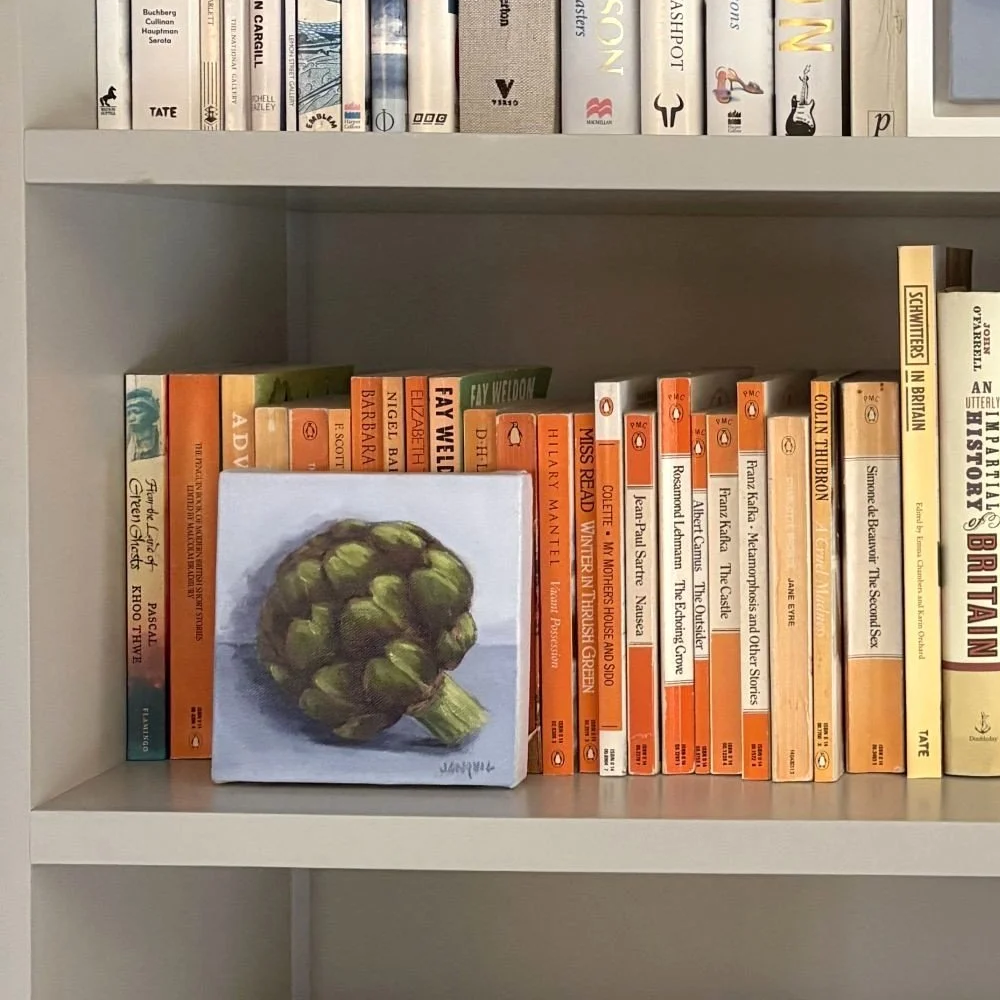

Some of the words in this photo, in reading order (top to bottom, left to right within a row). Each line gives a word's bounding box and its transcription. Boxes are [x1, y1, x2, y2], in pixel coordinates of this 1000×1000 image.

[254, 15, 263, 68] CARGILL
[150, 107, 177, 118] TATE
[908, 292, 924, 359] SCHWITTERS
[910, 370, 925, 382] IN
[815, 394, 828, 434] COLIN
[911, 387, 926, 431] BRITAIN
[548, 429, 559, 489] HILARY
[815, 439, 829, 501] THUBRON
[965, 411, 983, 511] HISTORY
[984, 411, 1000, 511] IMPARTIAL
[866, 466, 878, 503] Simone
[633, 494, 647, 547] Jean-Paul
[694, 500, 704, 534] Albert
[868, 505, 878, 517] de
[549, 500, 560, 566] MANTEL
[868, 519, 878, 564] Beauvoir
[635, 550, 647, 586] Sartre
[694, 536, 703, 572] Camus
[694, 582, 705, 603] The
[868, 567, 880, 588] The
[967, 533, 998, 657] BRITAIN
[131, 585, 141, 621] KHOO
[635, 596, 646, 636] Nausea
[869, 590, 881, 627] Second
[131, 625, 142, 664] THWE
[147, 603, 158, 647] PASCAL
[695, 604, 706, 650] Outsider
[870, 630, 881, 648] Sex
